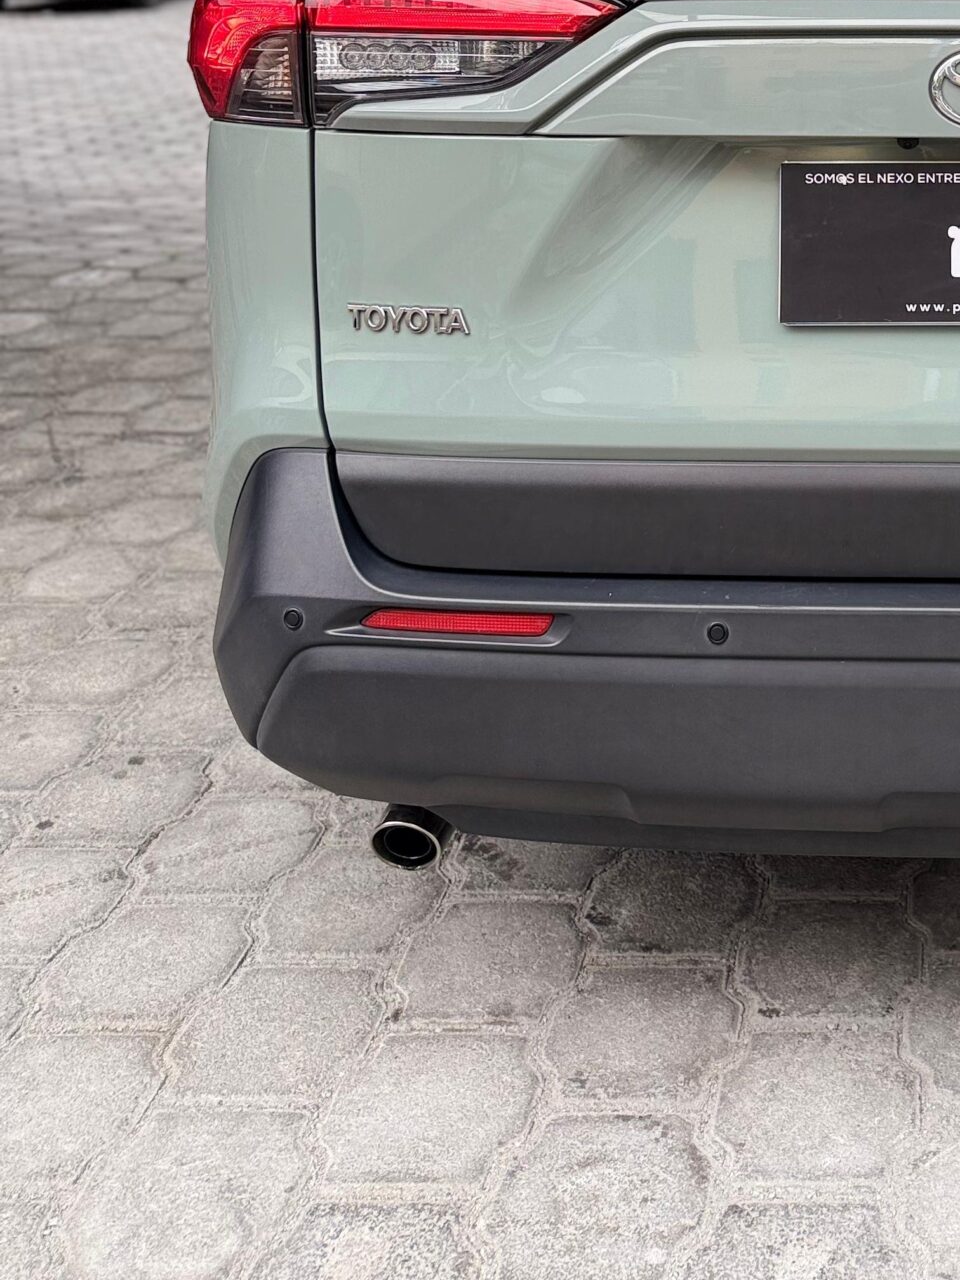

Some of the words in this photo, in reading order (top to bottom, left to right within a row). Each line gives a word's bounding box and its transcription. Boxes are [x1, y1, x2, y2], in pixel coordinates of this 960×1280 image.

[805, 173, 855, 186] SOMOS
[858, 173, 874, 184] EL
[877, 173, 915, 184] NEXO
[346, 303, 471, 335] TOYOTA
